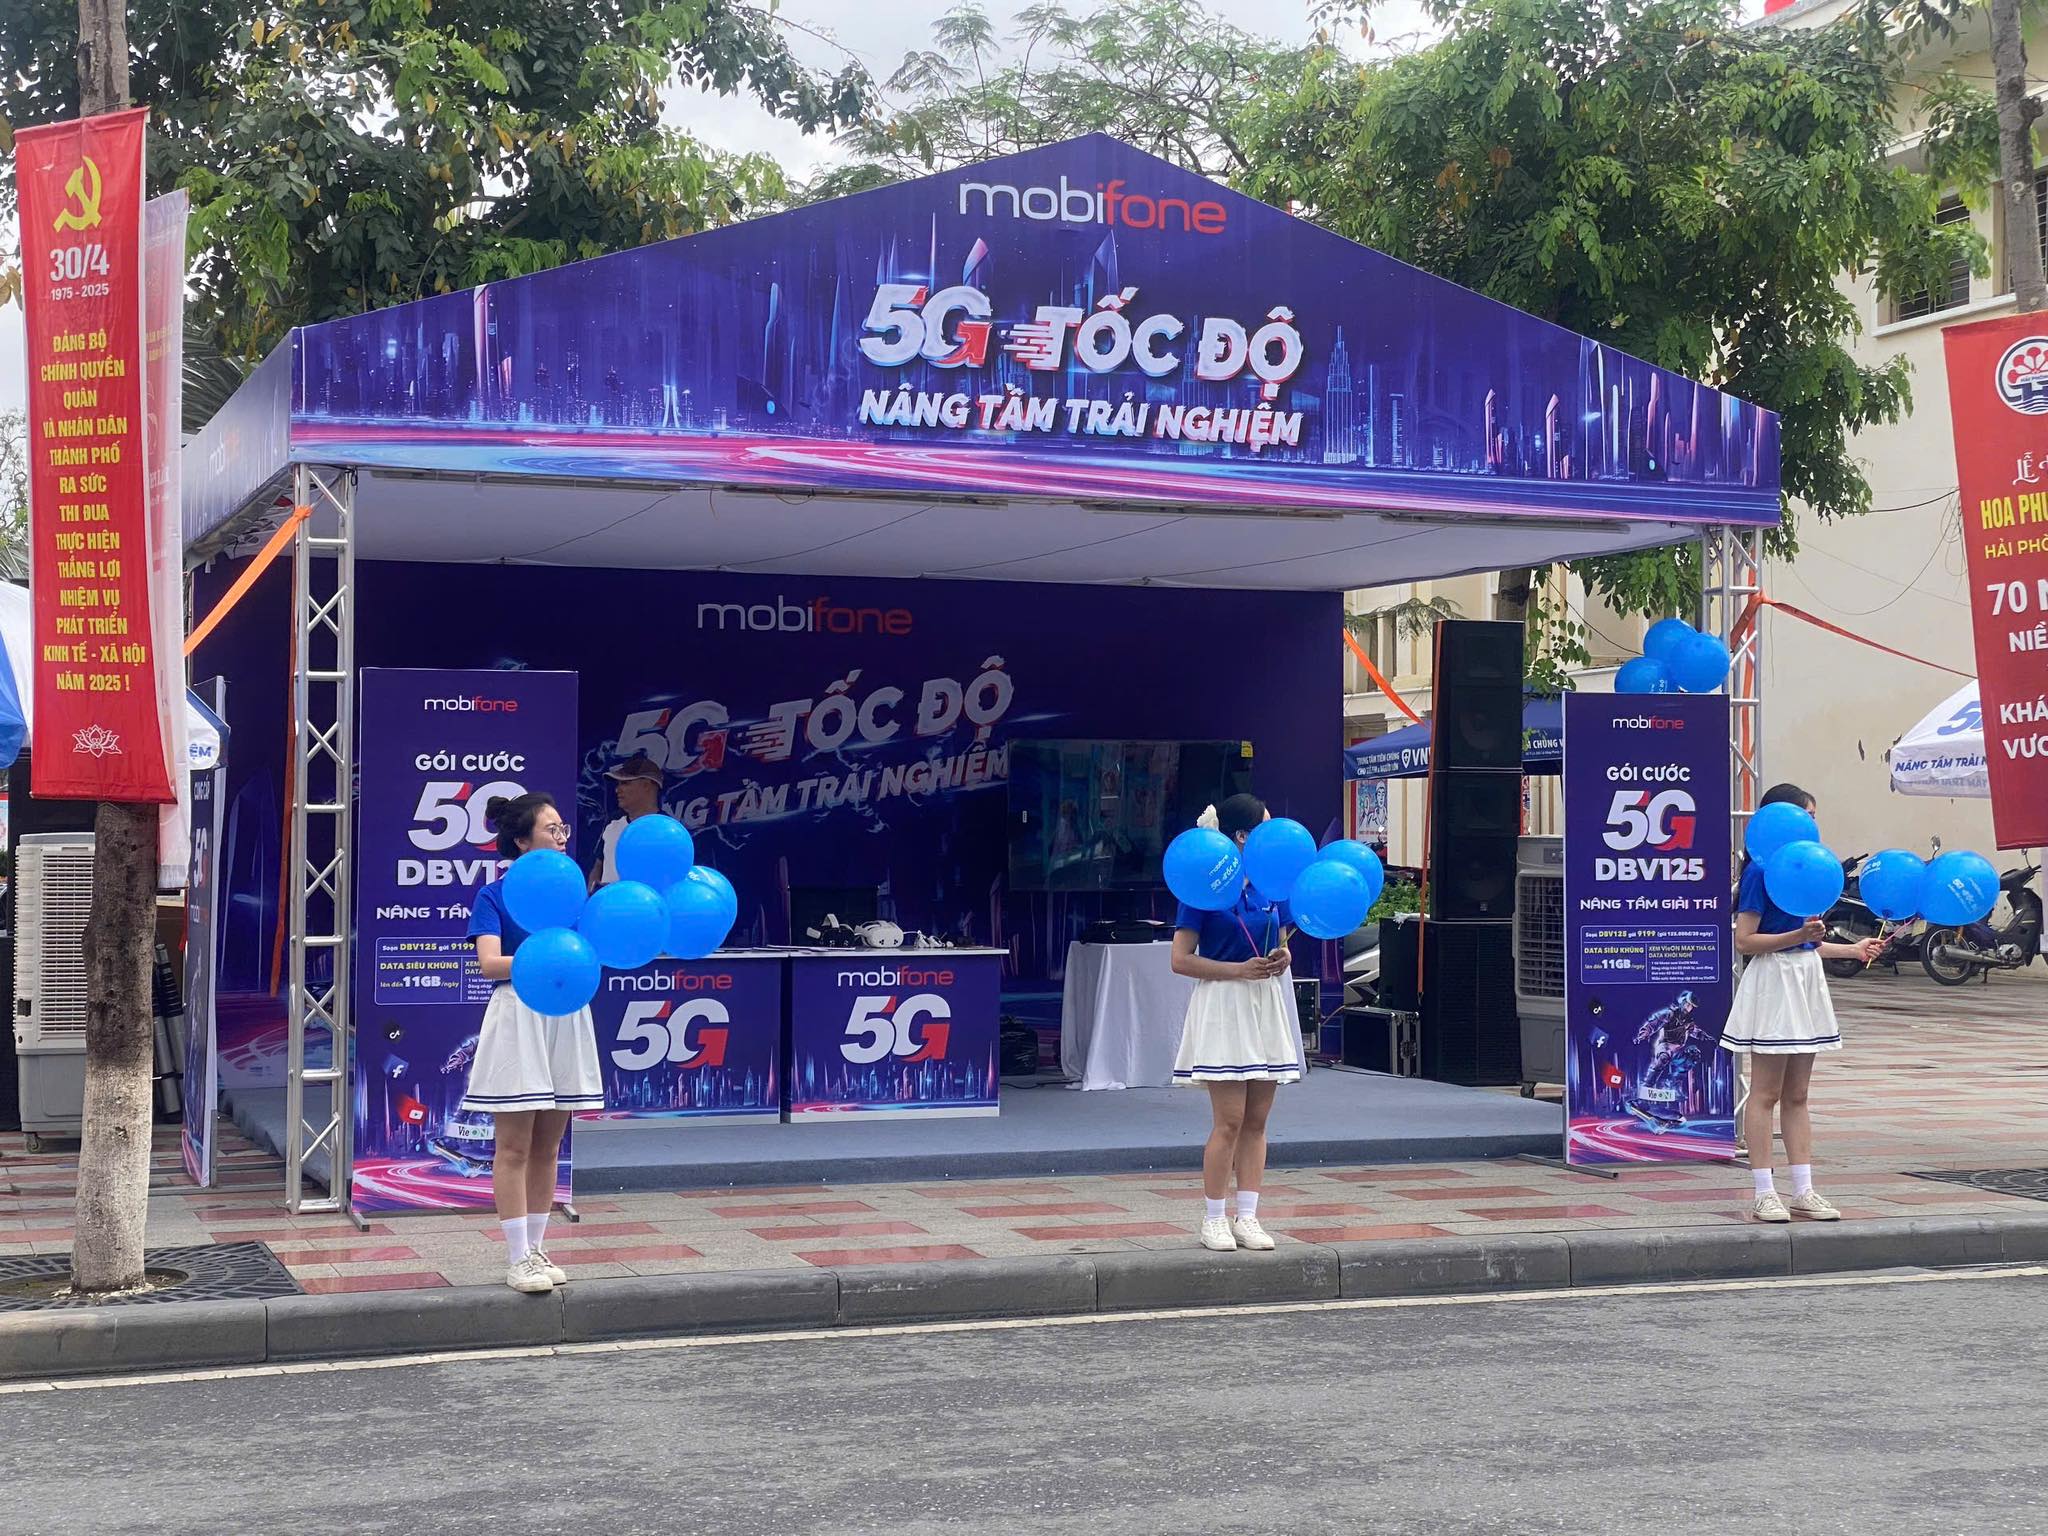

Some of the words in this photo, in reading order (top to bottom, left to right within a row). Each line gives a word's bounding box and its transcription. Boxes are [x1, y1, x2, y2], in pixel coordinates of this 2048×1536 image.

[959, 175, 1227, 235] mobifone
[50, 245, 110, 281] 30/4
[50, 286, 72, 300] 1975
[81, 283, 109, 297] 2025
[53, 329, 85, 353] ĐẢNG
[88, 330, 107, 352] BỘ
[859, 283, 993, 369] 5G
[1006, 287, 1184, 377] TỐC
[1195, 306, 1304, 400] ĐỘ
[41, 357, 78, 382] CHÍNH
[80, 354, 125, 379] QUYỀN
[63, 386, 97, 408] QUÂN
[43, 415, 56, 439] VÀ
[58, 414, 93, 437] NHÂN
[97, 411, 127, 434] DÂN
[859, 382, 970, 429] NÂNG
[975, 382, 1058, 432] TẦM
[1065, 391, 1147, 437] TRẢI
[1153, 402, 1303, 452] NGHIỆM
[50, 443, 88, 466] THÀNH
[91, 440, 122, 464] PHỐ
[2013, 452, 2041, 485] LỄ
[59, 476, 77, 494] RA
[80, 473, 107, 493] SỨC
[59, 505, 79, 522] THI
[83, 504, 109, 521] ĐUA
[1980, 496, 2016, 529] HOA
[56, 532, 84, 553] THỰC
[87, 529, 120, 551] HIỆN
[1985, 538, 2013, 559] HẢI
[57, 558, 96, 579] THẮNG
[99, 560, 121, 580] LỢI
[60, 588, 99, 610] NHIỆM
[102, 589, 120, 610] VỤ
[1987, 581, 2027, 616] 70
[56, 616, 85, 635] PHÁT
[88, 613, 128, 635] TRIỂN
[698, 595, 913, 635] mobifone
[44, 645, 69, 662] KINH
[72, 640, 88, 663] TẾ
[100, 643, 119, 663] XÃ
[123, 643, 145, 667] HỘI
[56, 670, 85, 692] NĂM
[89, 673, 121, 691] 2025
[424, 695, 518, 713] mobifone
[615, 700, 729, 777] 5G
[738, 669, 904, 763] TỐC
[914, 654, 1015, 743] ĐỘ
[1613, 715, 1685, 729] mobifone
[415, 750, 456, 771] GÓI
[462, 750, 525, 772] CƯỚC
[1412, 747, 1431, 766] VN
[1895, 759, 1928, 772] NÂNG
[1606, 763, 1638, 781] GÓI
[1642, 763, 1691, 782] CƯỚC
[662, 797, 709, 827] NG
[717, 779, 788, 823] TẦM
[795, 767, 874, 812] TRẢI
[877, 741, 1009, 800] NGHIỆM
[1602, 789, 1696, 851] 5G
[397, 859, 512, 886] DBV12
[1595, 858, 1705, 881] DBV125
[376, 903, 430, 920] NÂNG
[1580, 898, 1621, 910] NÂNG
[1625, 896, 1658, 909] TẦM
[1661, 896, 1689, 909] GIẢI
[1693, 896, 1717, 909] TRÍ
[400, 943, 437, 951] DBV125
[450, 943, 475, 951] 9199
[380, 962, 405, 970] DATA
[406, 960, 426, 970] SIÊU
[427, 960, 459, 970] KHỦNG
[1601, 959, 1631, 969] 11GB
[402, 976, 441, 988] 11GB
[609, 970, 732, 991] mobifone
[837, 966, 954, 988] mobifone
[610, 998, 730, 1071] 5G
[839, 993, 951, 1065] 5G
